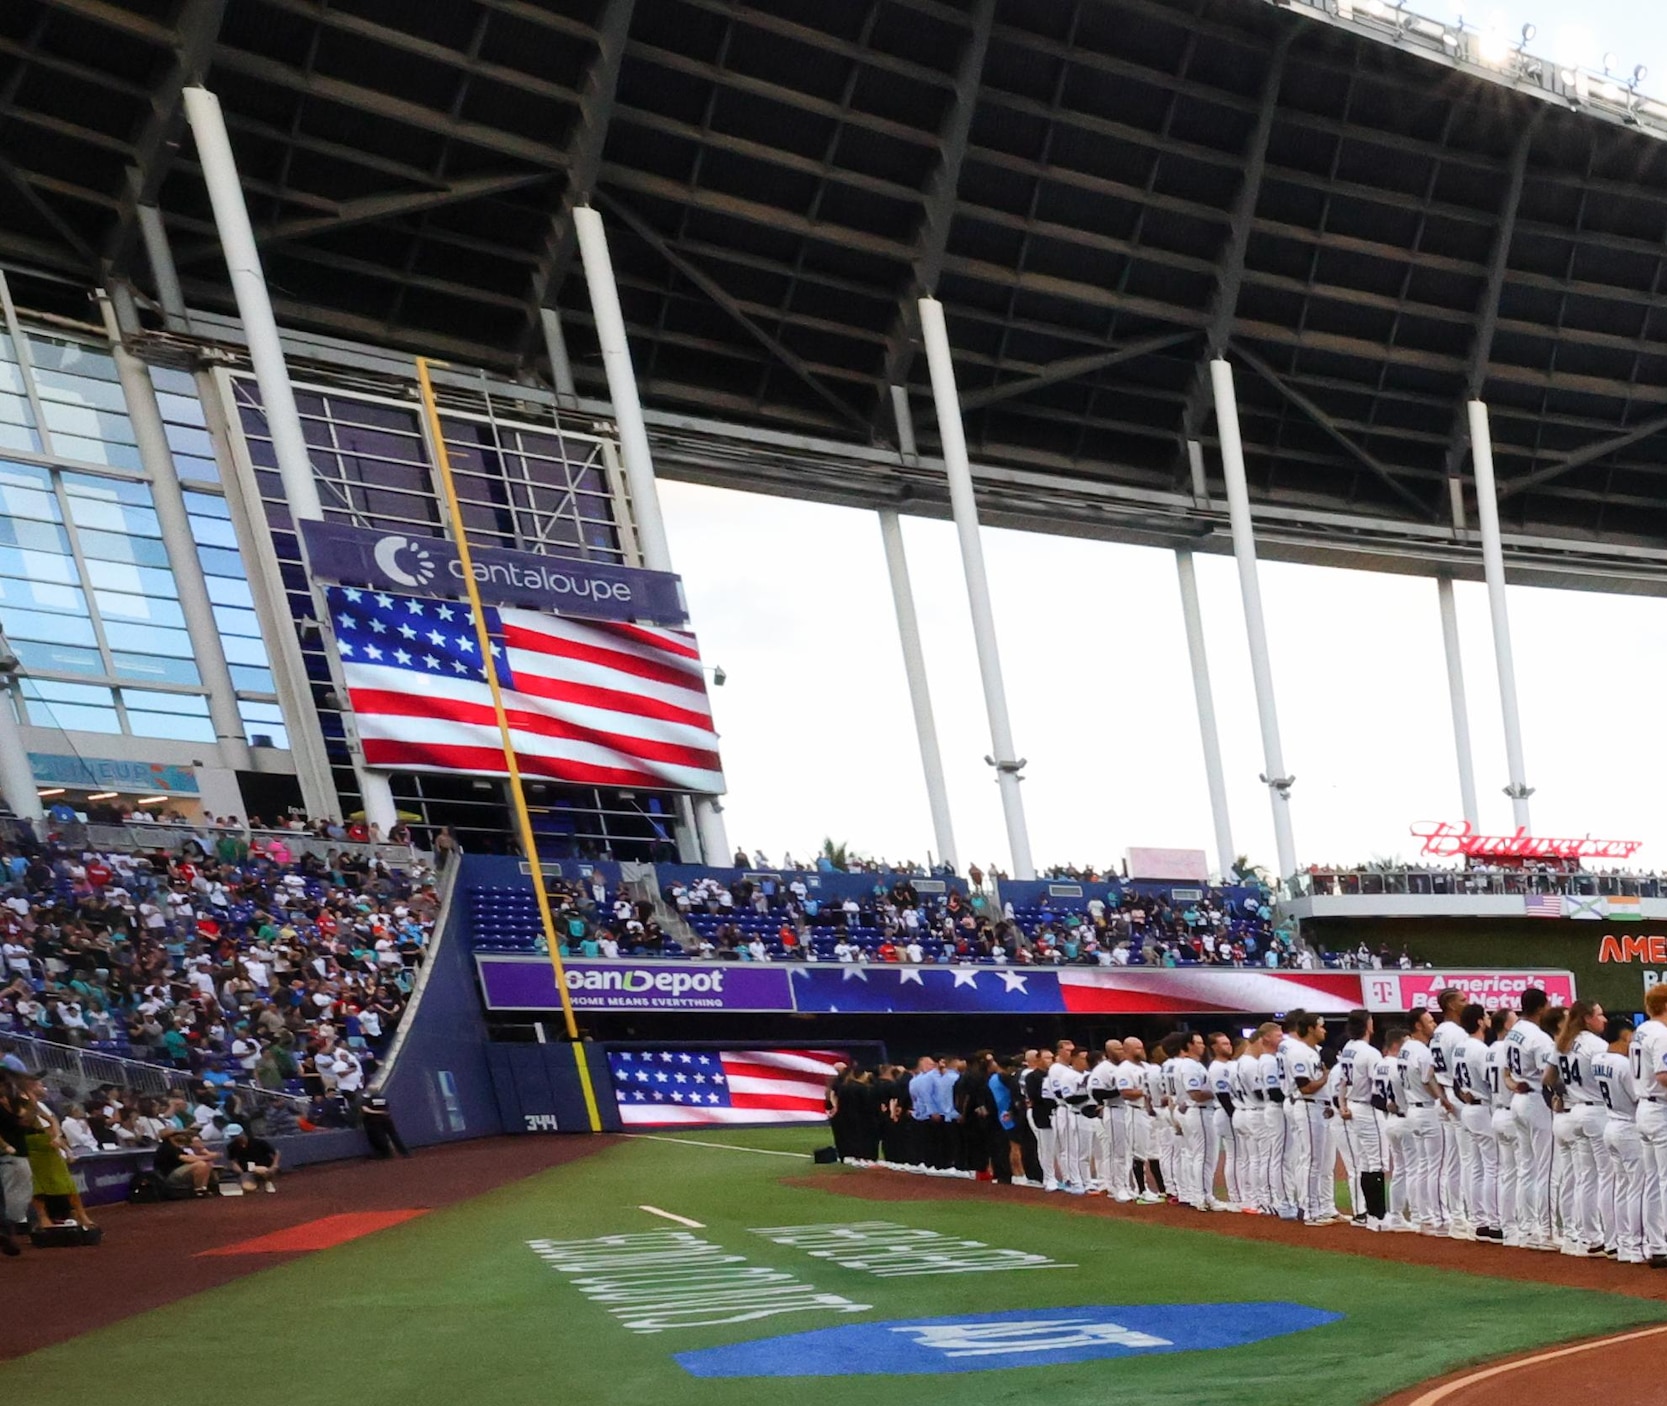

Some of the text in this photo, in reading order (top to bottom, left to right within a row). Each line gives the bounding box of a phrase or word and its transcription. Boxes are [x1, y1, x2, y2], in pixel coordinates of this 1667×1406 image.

[448, 557, 632, 602] cantaloupe
[1410, 820, 1644, 859] Budweiser
[555, 969, 723, 995] oanDepot
[1428, 975, 1545, 992] America's
[569, 996, 723, 1008] HOME MEANS EVERYTHING
[524, 1114, 558, 1132] 344
